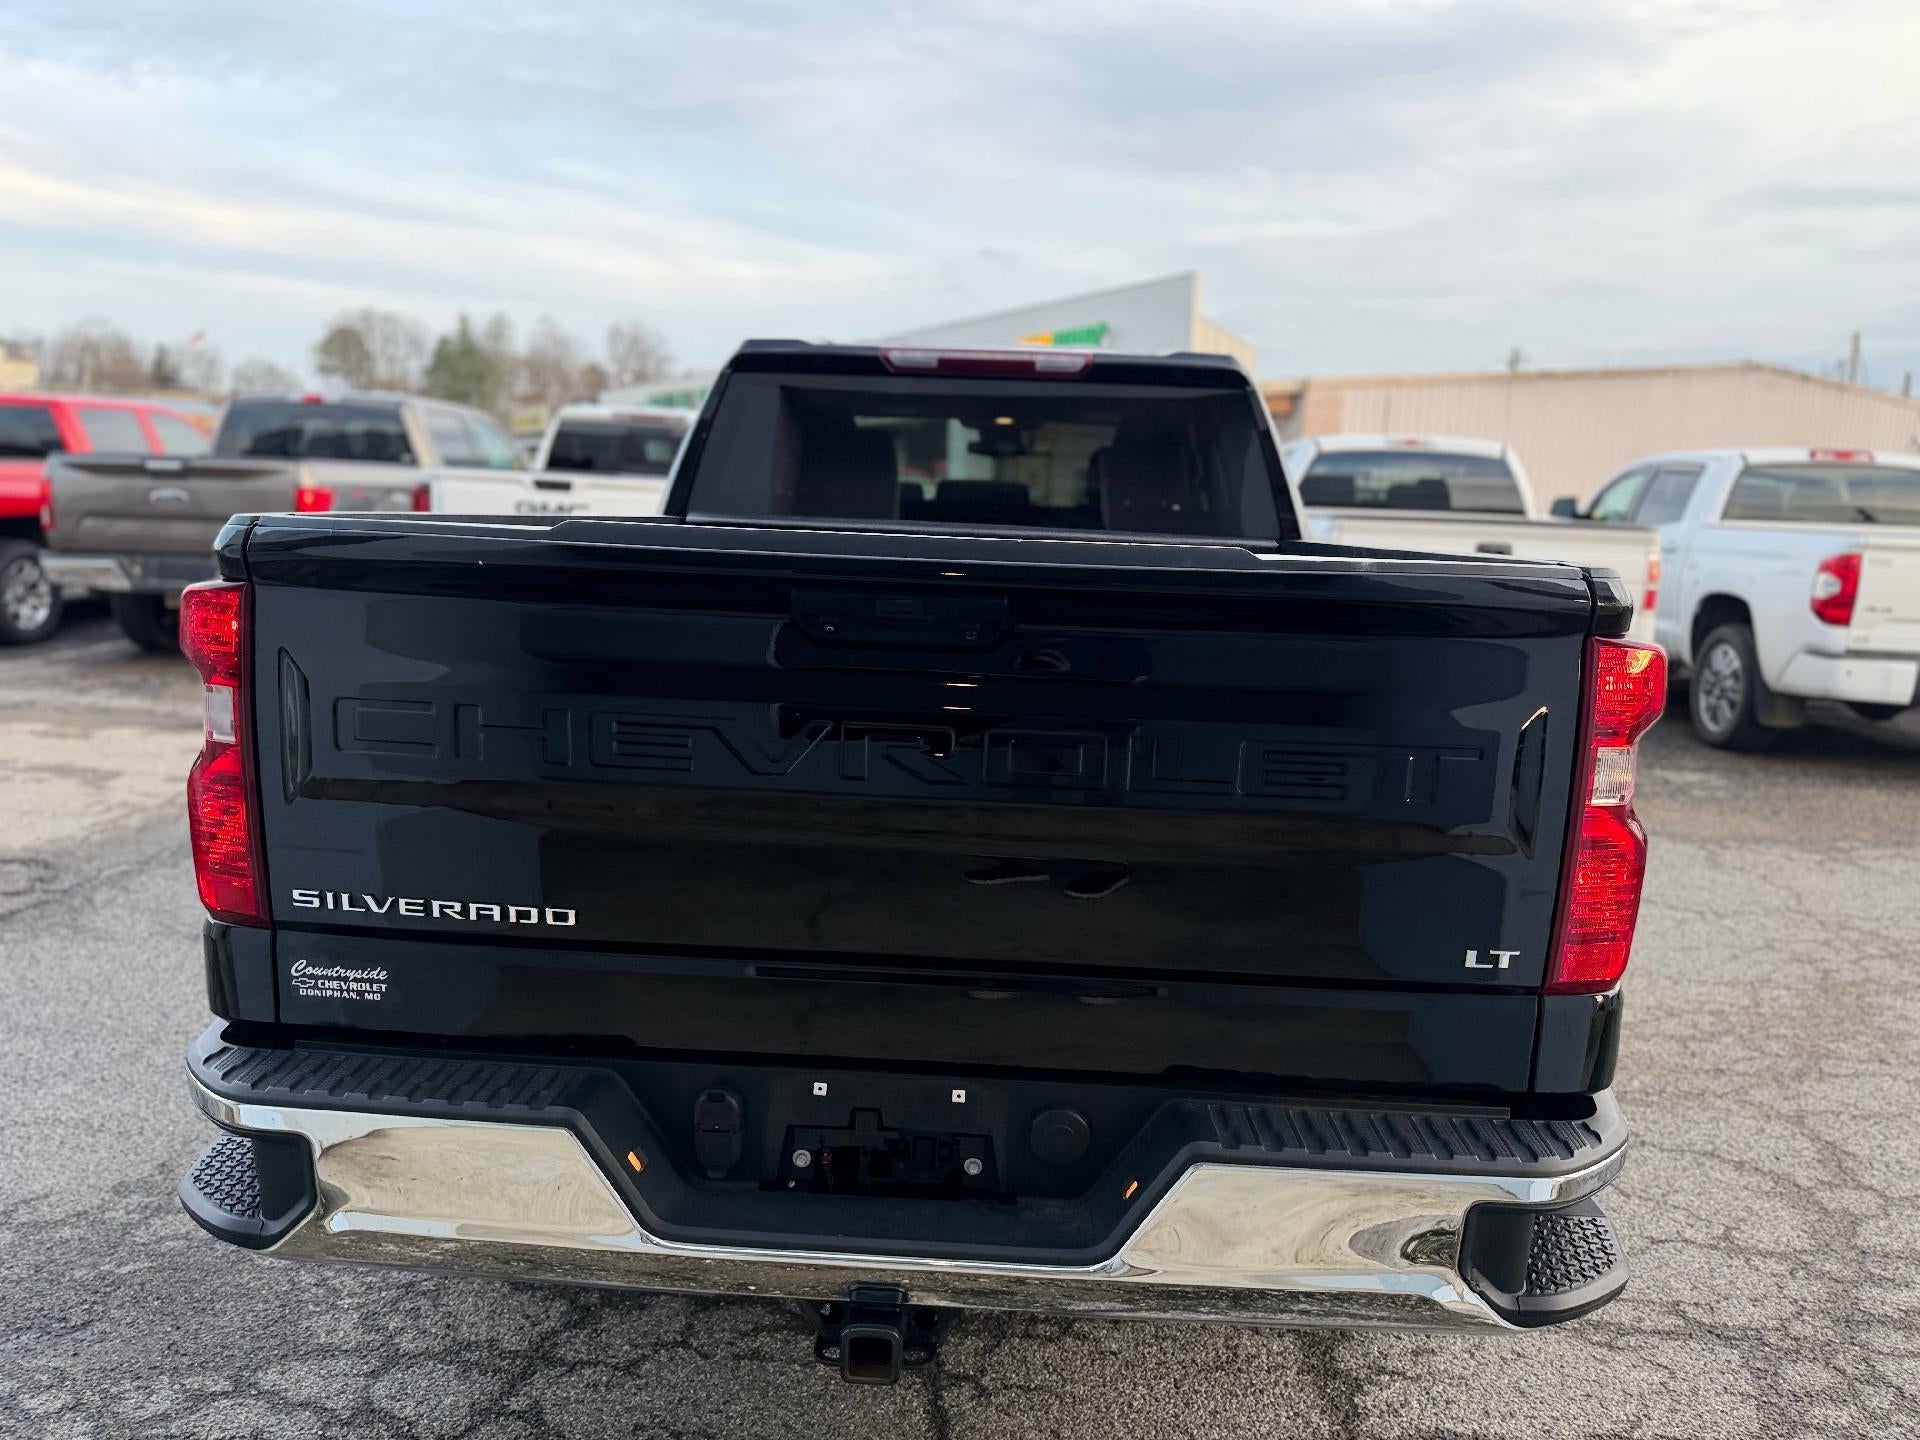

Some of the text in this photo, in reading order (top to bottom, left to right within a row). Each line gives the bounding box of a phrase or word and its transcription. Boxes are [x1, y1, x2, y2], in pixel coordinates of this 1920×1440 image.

[332, 695, 1486, 805] CHEVROLET
[291, 888, 577, 927] SILVERADO
[1464, 949, 1521, 969] LT
[290, 959, 389, 981] Countryside
[317, 979, 388, 992] CHEVROLET
[364, 992, 381, 1001] MO
